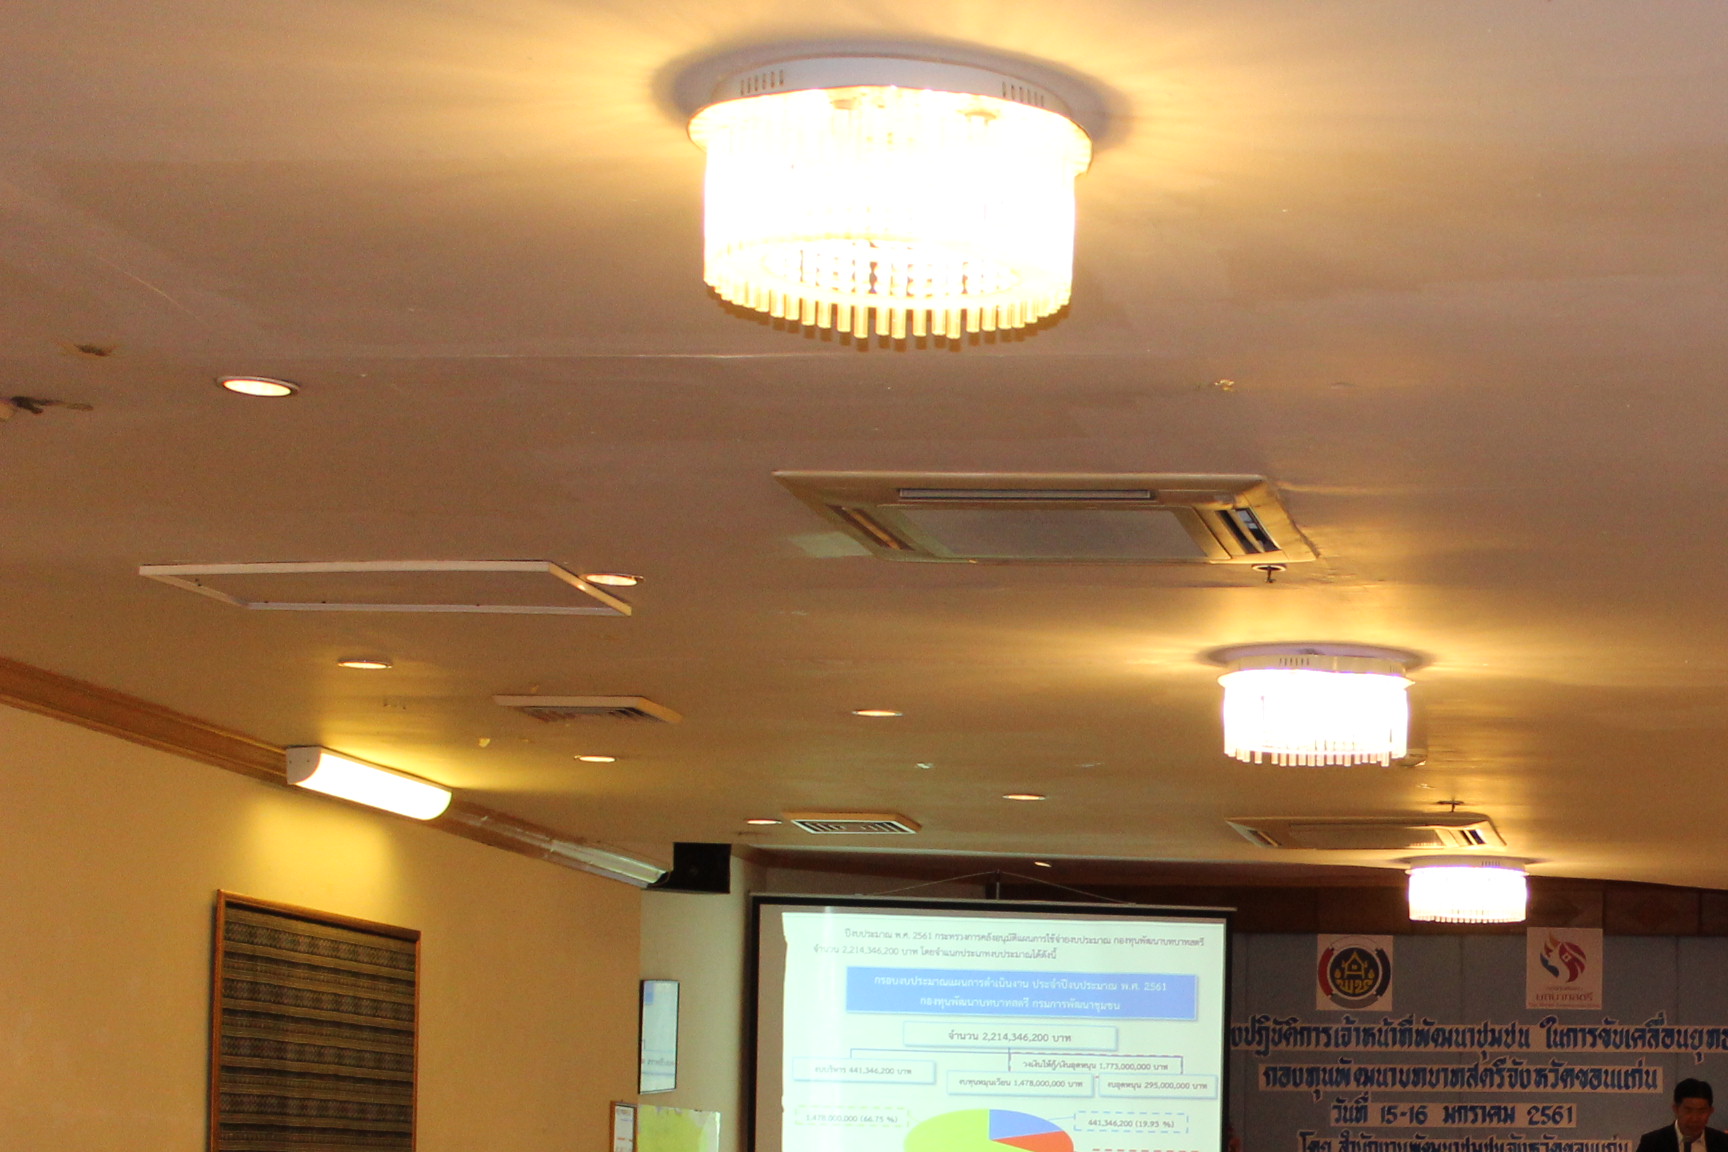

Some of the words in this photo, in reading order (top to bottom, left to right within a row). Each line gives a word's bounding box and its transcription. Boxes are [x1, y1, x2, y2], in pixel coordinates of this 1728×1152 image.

[913, 931, 932, 940] 2561
[1144, 982, 1167, 991] 2561
[948, 1030, 979, 1041] จำนวน
[982, 1032, 1049, 1043] 2,214,346,200
[1052, 1033, 1072, 1043] บาท
[1143, 1081, 1190, 1091] 295,000,000
[1332, 1091, 1369, 1124] วันที่
[1380, 1105, 1428, 1125] 15-16
[1442, 1104, 1516, 1124] มกราคม
[1527, 1105, 1574, 1126] 2561
